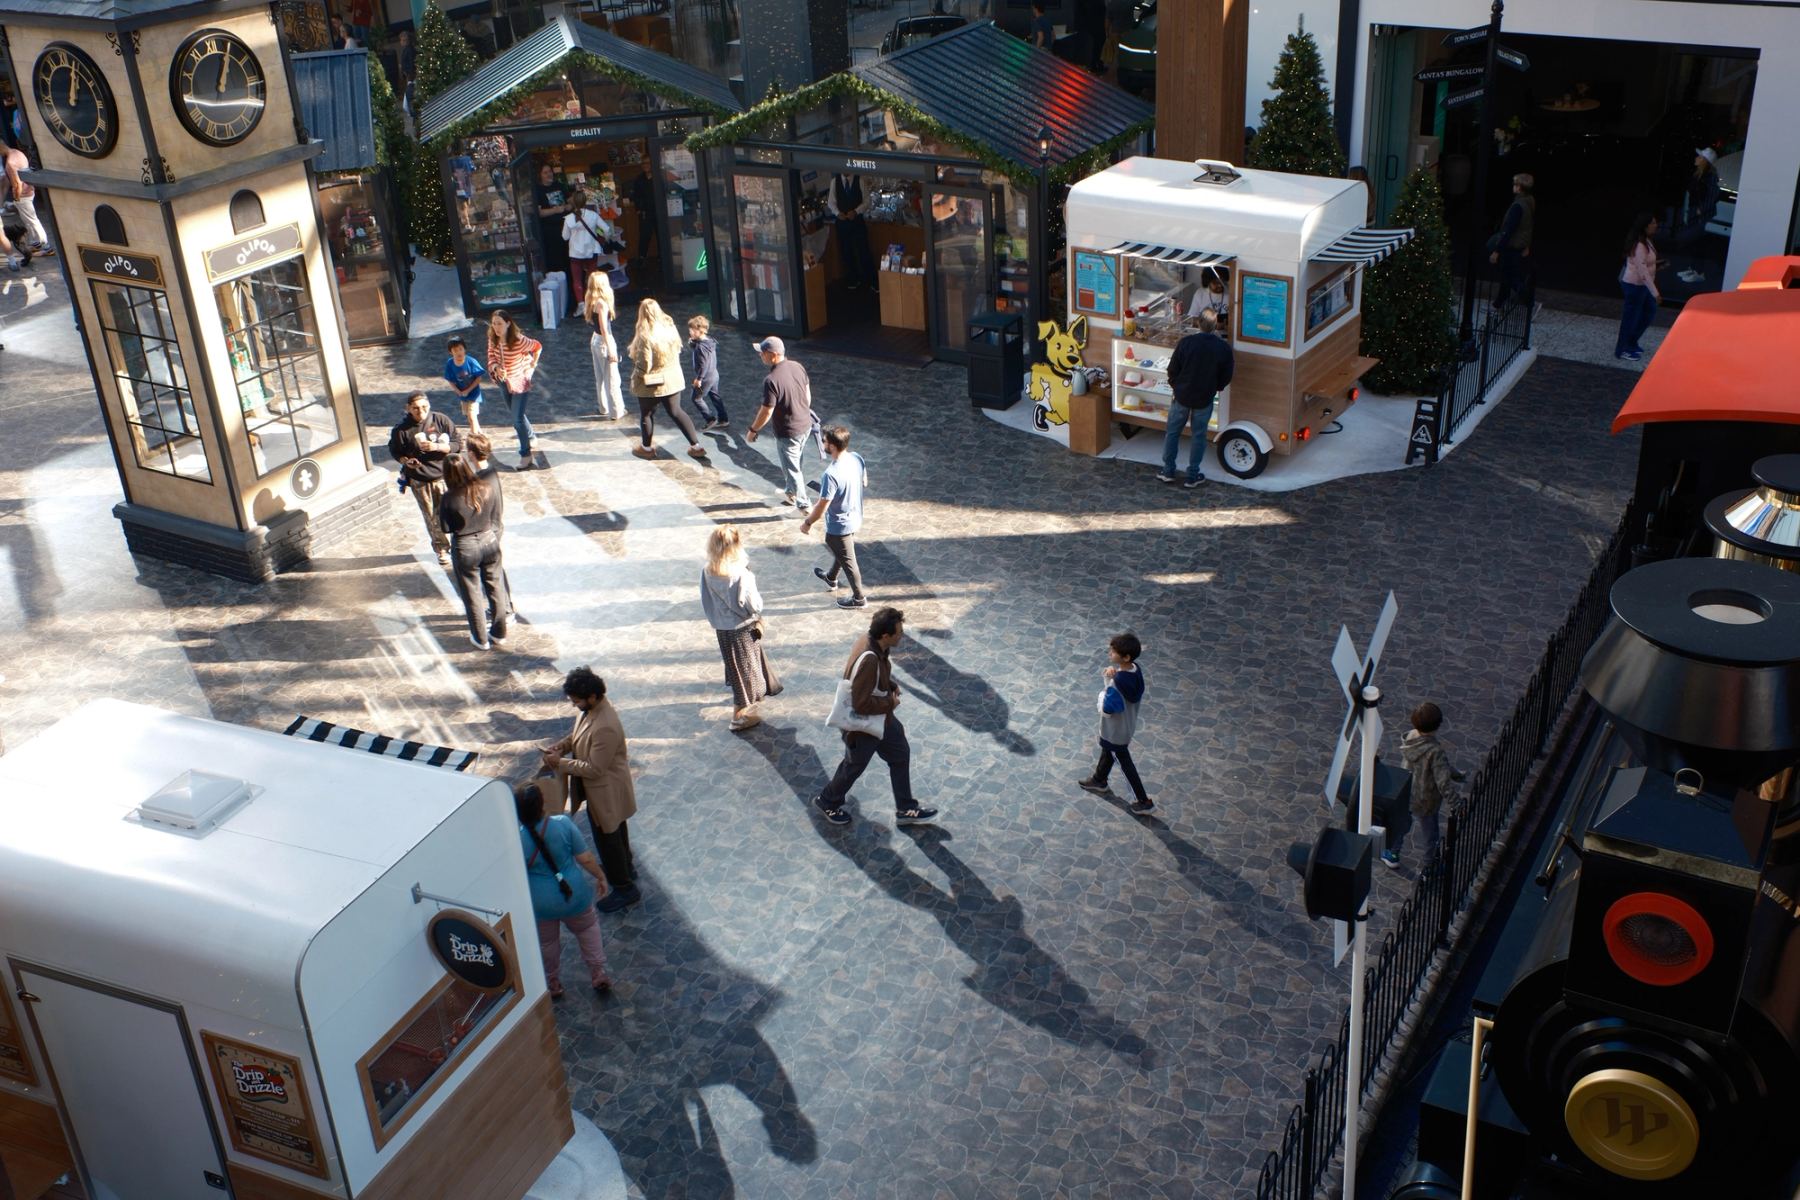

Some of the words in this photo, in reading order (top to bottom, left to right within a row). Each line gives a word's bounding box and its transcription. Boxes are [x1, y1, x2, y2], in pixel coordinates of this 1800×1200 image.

[1445, 67, 1485, 77] BUNGALOW
[570, 127, 602, 138] CREALITY
[852, 159, 877, 170] SWEETS
[236, 238, 279, 266] OLIPOP
[104, 255, 139, 278] OLIPOP
[449, 937, 479, 954] Drip
[451, 948, 495, 967] Drizzle
[232, 1066, 265, 1081] Drip
[237, 1079, 284, 1095] Drizzle
